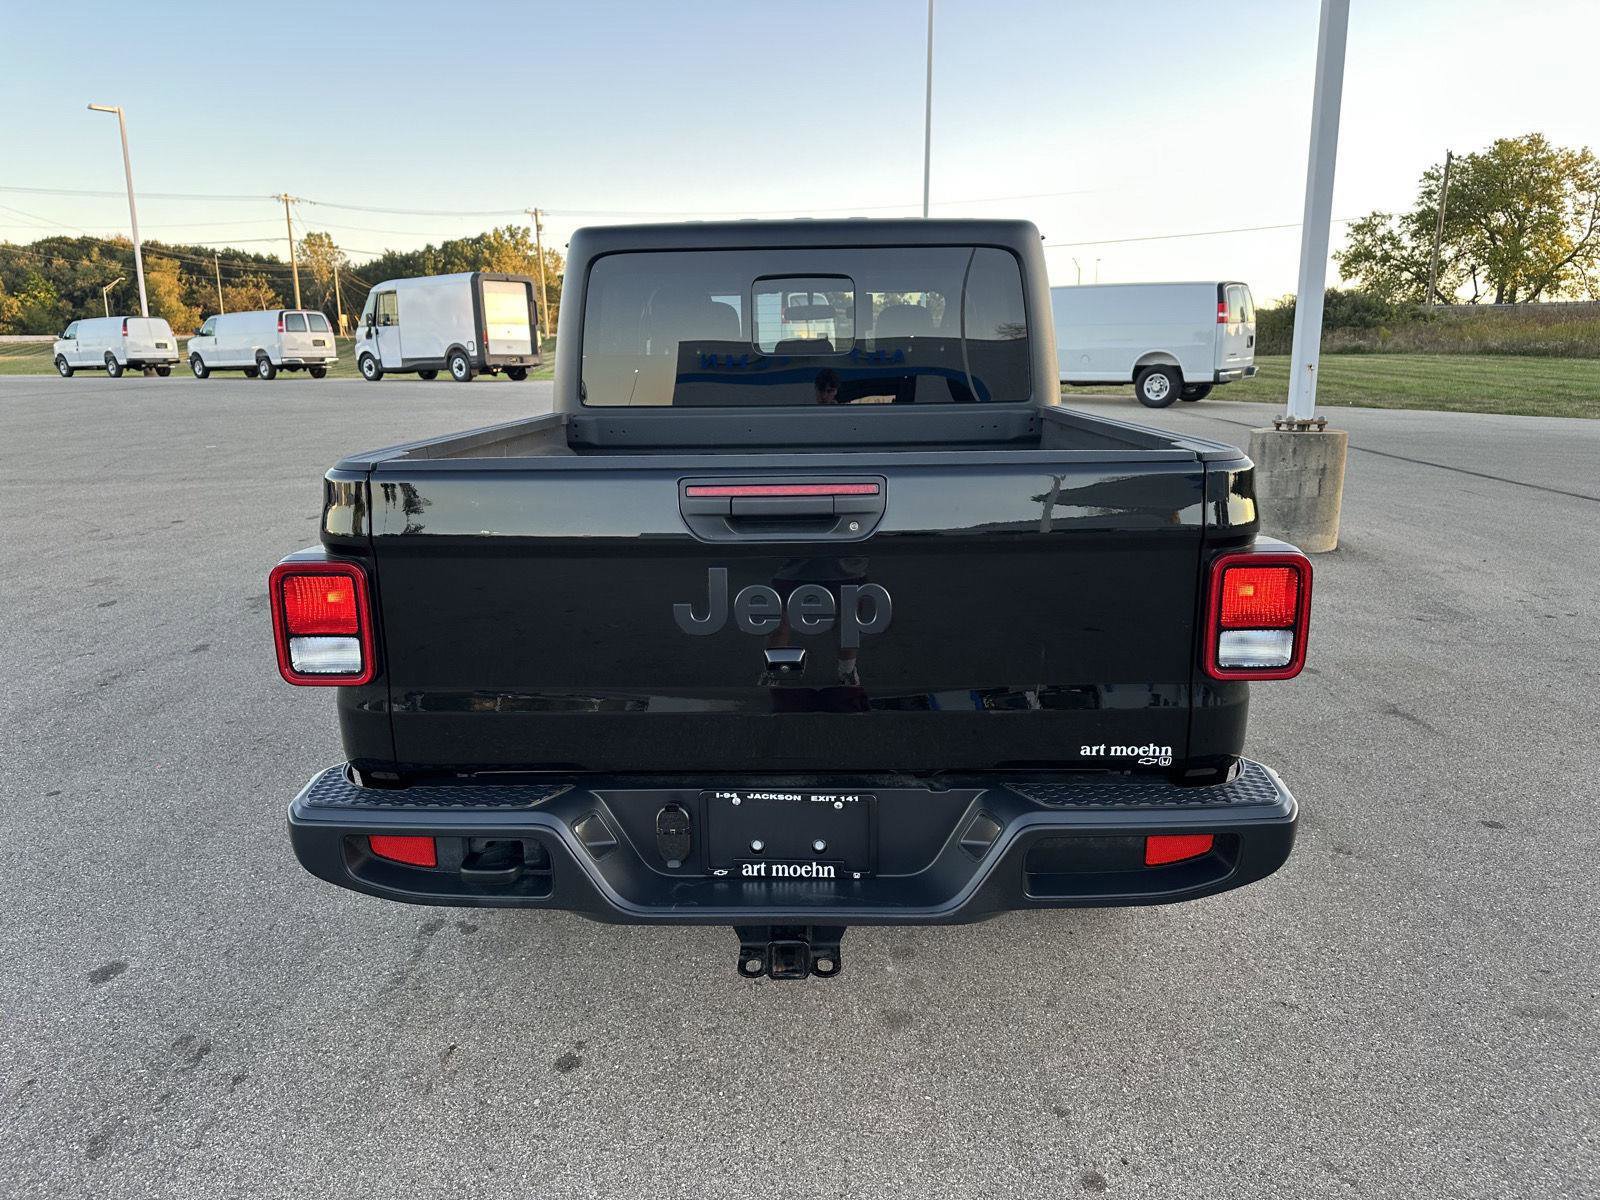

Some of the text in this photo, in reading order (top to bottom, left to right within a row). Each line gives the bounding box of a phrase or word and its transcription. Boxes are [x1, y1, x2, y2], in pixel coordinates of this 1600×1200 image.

[672, 567, 892, 649] Jeep
[1079, 743, 1173, 757] art moehn
[746, 793, 802, 801] JACKSON
[741, 861, 836, 878] art moehn
